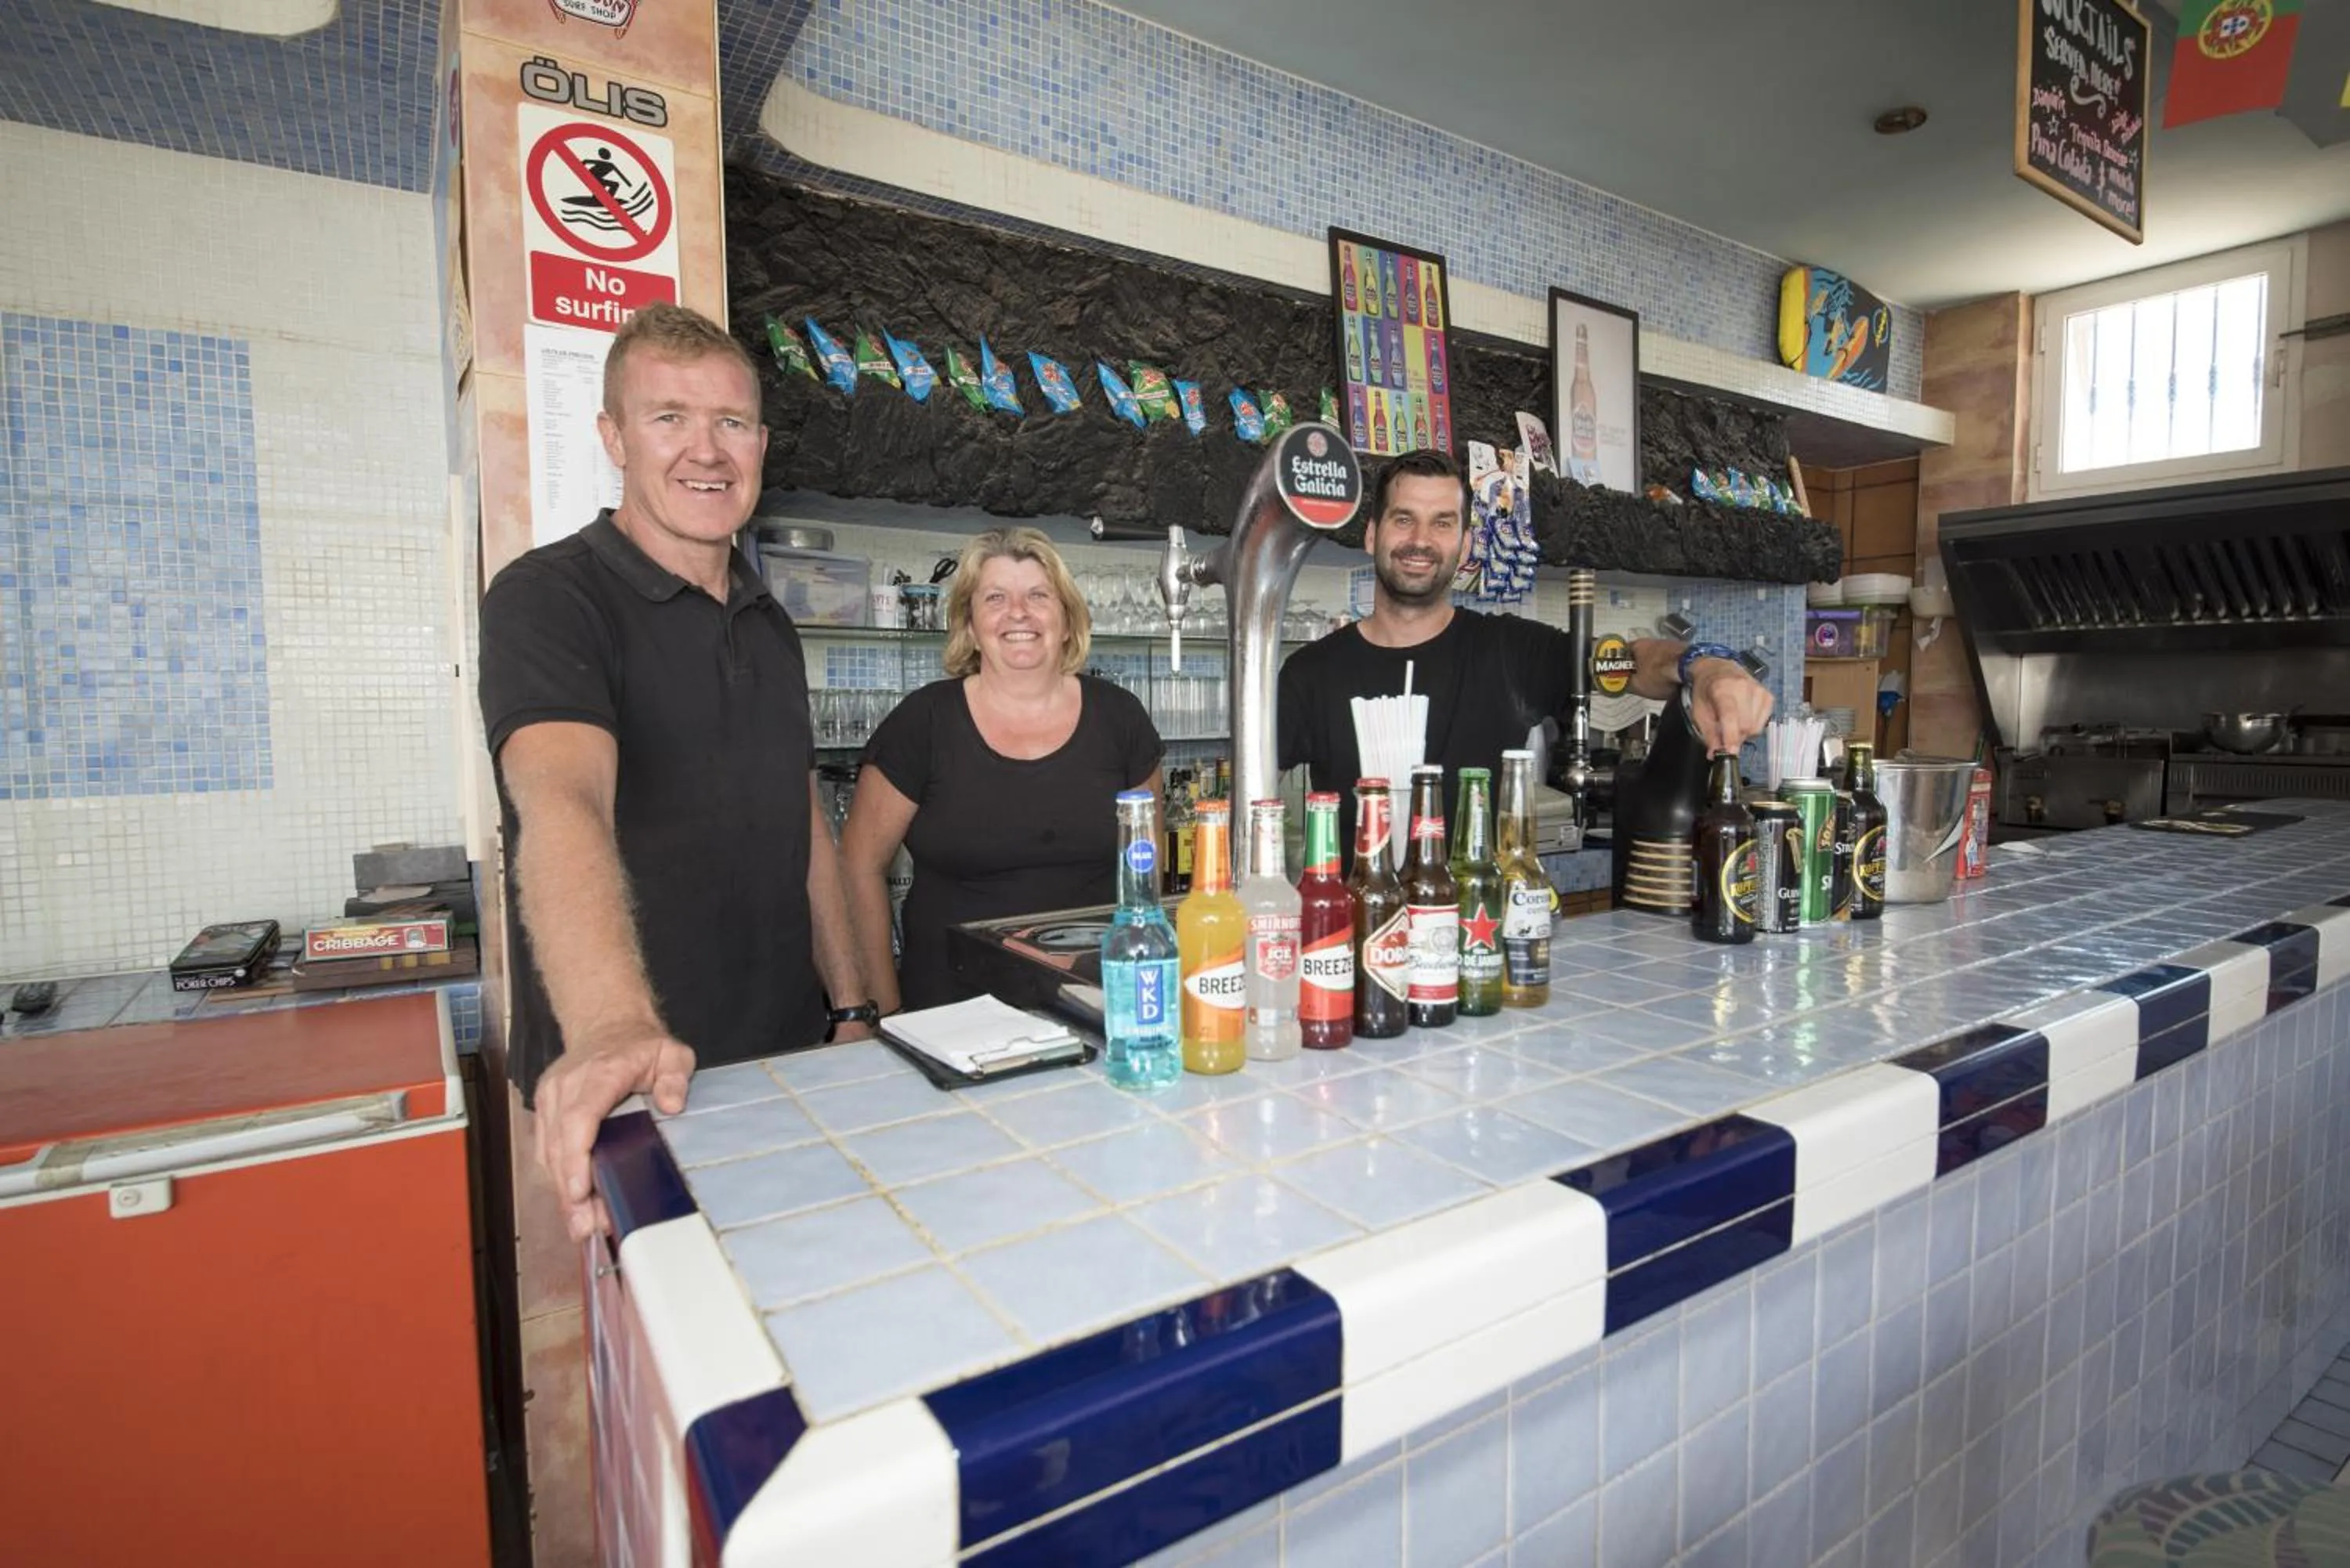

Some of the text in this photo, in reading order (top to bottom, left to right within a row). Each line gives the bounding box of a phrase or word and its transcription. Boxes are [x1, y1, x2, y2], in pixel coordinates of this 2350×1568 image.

[591, 5, 616, 18] SHOP
[520, 56, 667, 127] ÖLIS
[585, 267, 626, 296] No
[1292, 455, 1347, 479] Estrella
[1294, 474, 1346, 497] Galicia
[313, 934, 400, 952] CRIBBAGE
[208, 976, 236, 987] CHIPS
[1140, 969, 1159, 1020] WKD
